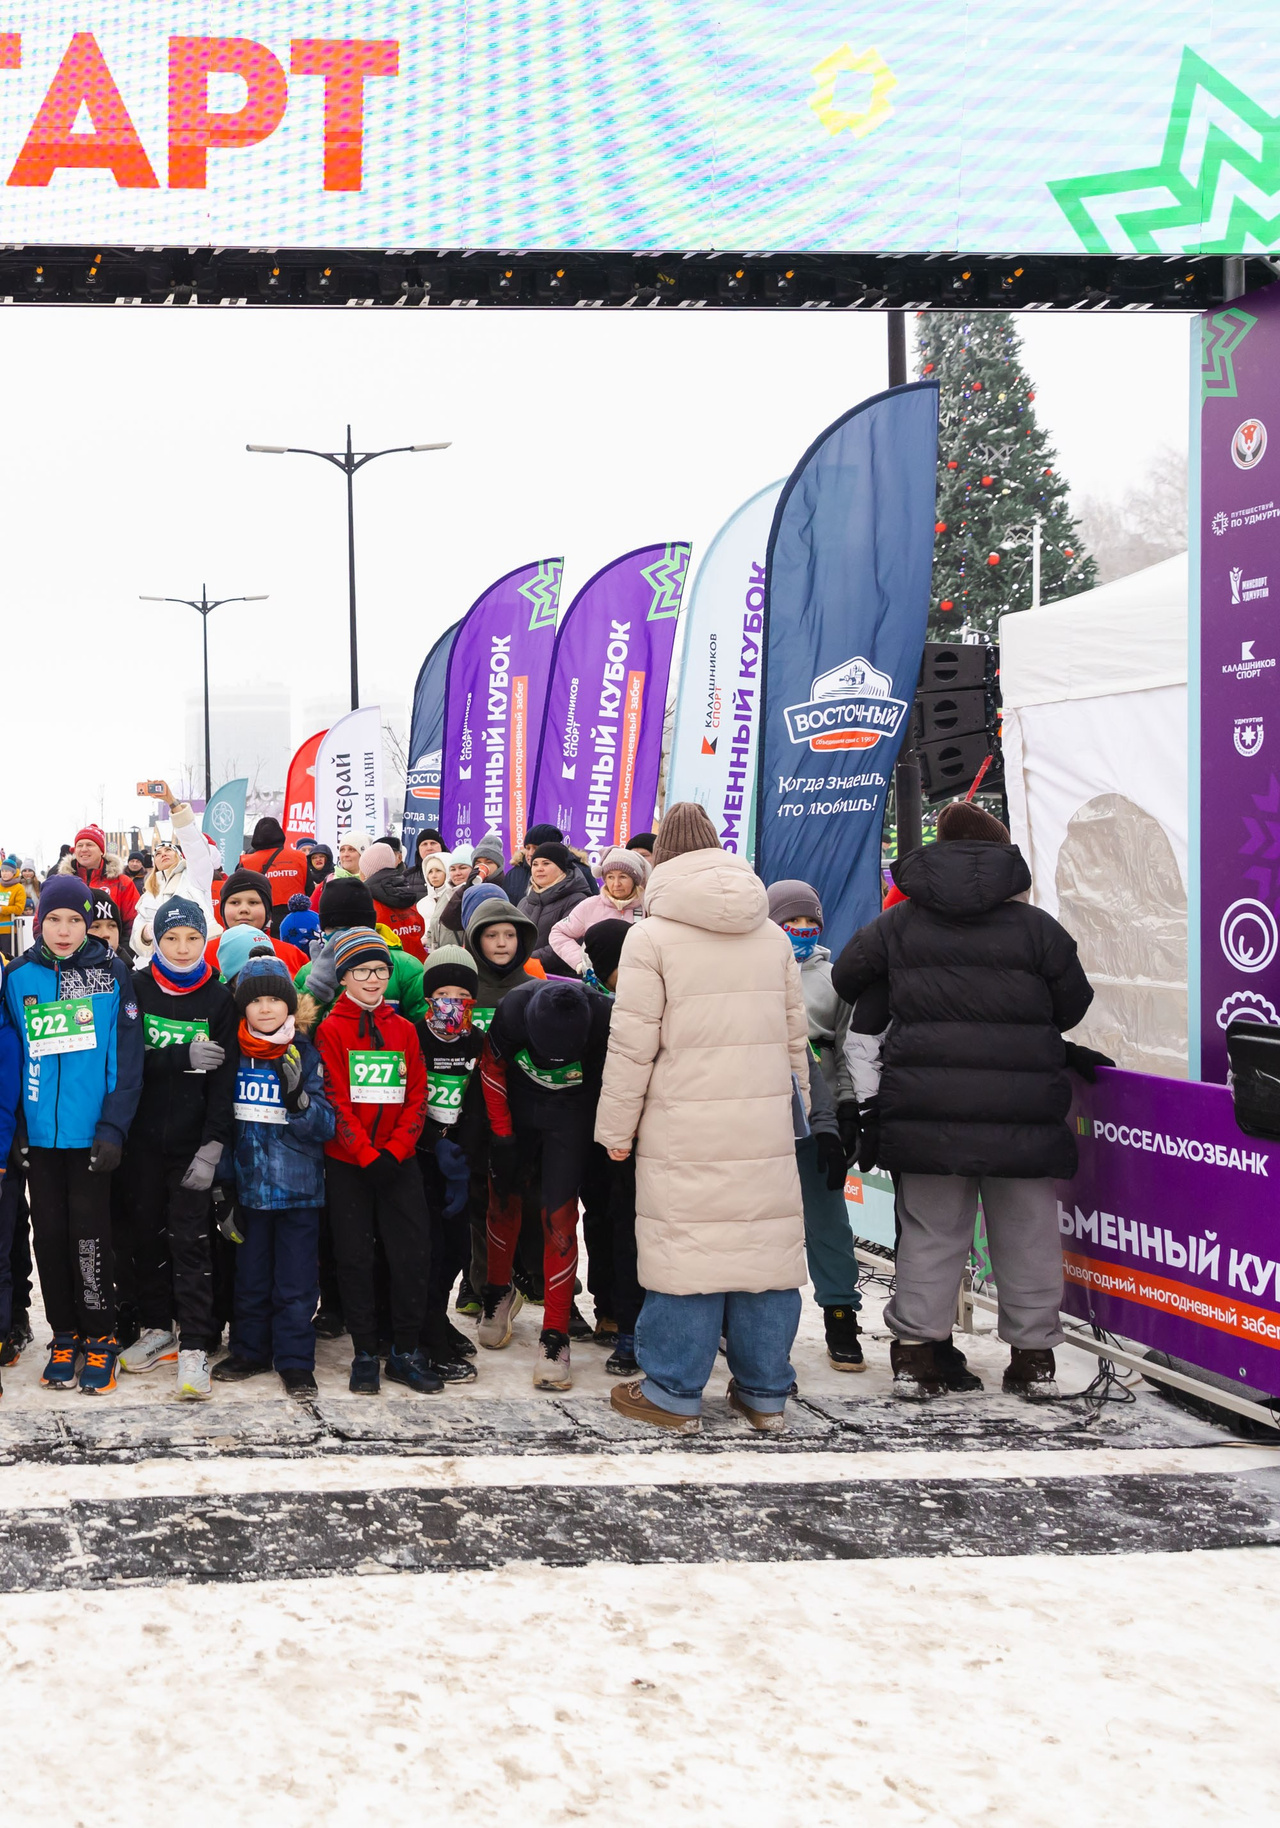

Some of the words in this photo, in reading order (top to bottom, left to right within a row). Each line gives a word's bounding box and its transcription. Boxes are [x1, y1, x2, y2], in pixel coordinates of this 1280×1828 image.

[1231, 501, 1274, 518] ПУТЕШЕСТВУЙ
[1231, 518, 1242, 528] ПО
[1244, 509, 1280, 525] УДМУРТИ
[739, 561, 766, 678] КУБОК
[488, 634, 511, 722] КУБОК
[599, 619, 631, 718] КУБОК
[705, 633, 717, 728] КАЛАШНИКОВ
[1222, 658, 1276, 673] КАЛАШНИКОВ
[1236, 669, 1261, 680] СПОРТ
[563, 677, 579, 757] КАЛАШНИКОВ
[712, 686, 721, 728] СПОРТ
[794, 704, 899, 732] ВОСТОЧНЫЙ
[1233, 717, 1263, 725] УДМУРТИЯ
[459, 692, 472, 761] КАЛАШНИКОВ
[570, 721, 581, 758] СПОРТ
[624, 712, 637, 799] многодневный
[631, 676, 641, 710] забег
[465, 729, 473, 761] СПОРТ
[515, 712, 524, 787] многодневный
[363, 752, 375, 787] БАНИ
[778, 776, 824, 793] Когда
[826, 772, 886, 789] знаешь,
[365, 793, 376, 820] ДЛЯ
[807, 795, 877, 815] любишь!
[31, 1014, 68, 1037] 922
[148, 1026, 185, 1049] 923
[354, 1063, 394, 1083] 927
[238, 1081, 281, 1104] 1011
[427, 1083, 462, 1106] 926
[1094, 1119, 1269, 1177] РОССЕЛЬХОЗБАНК
[1139, 1283, 1237, 1326] многодневный
